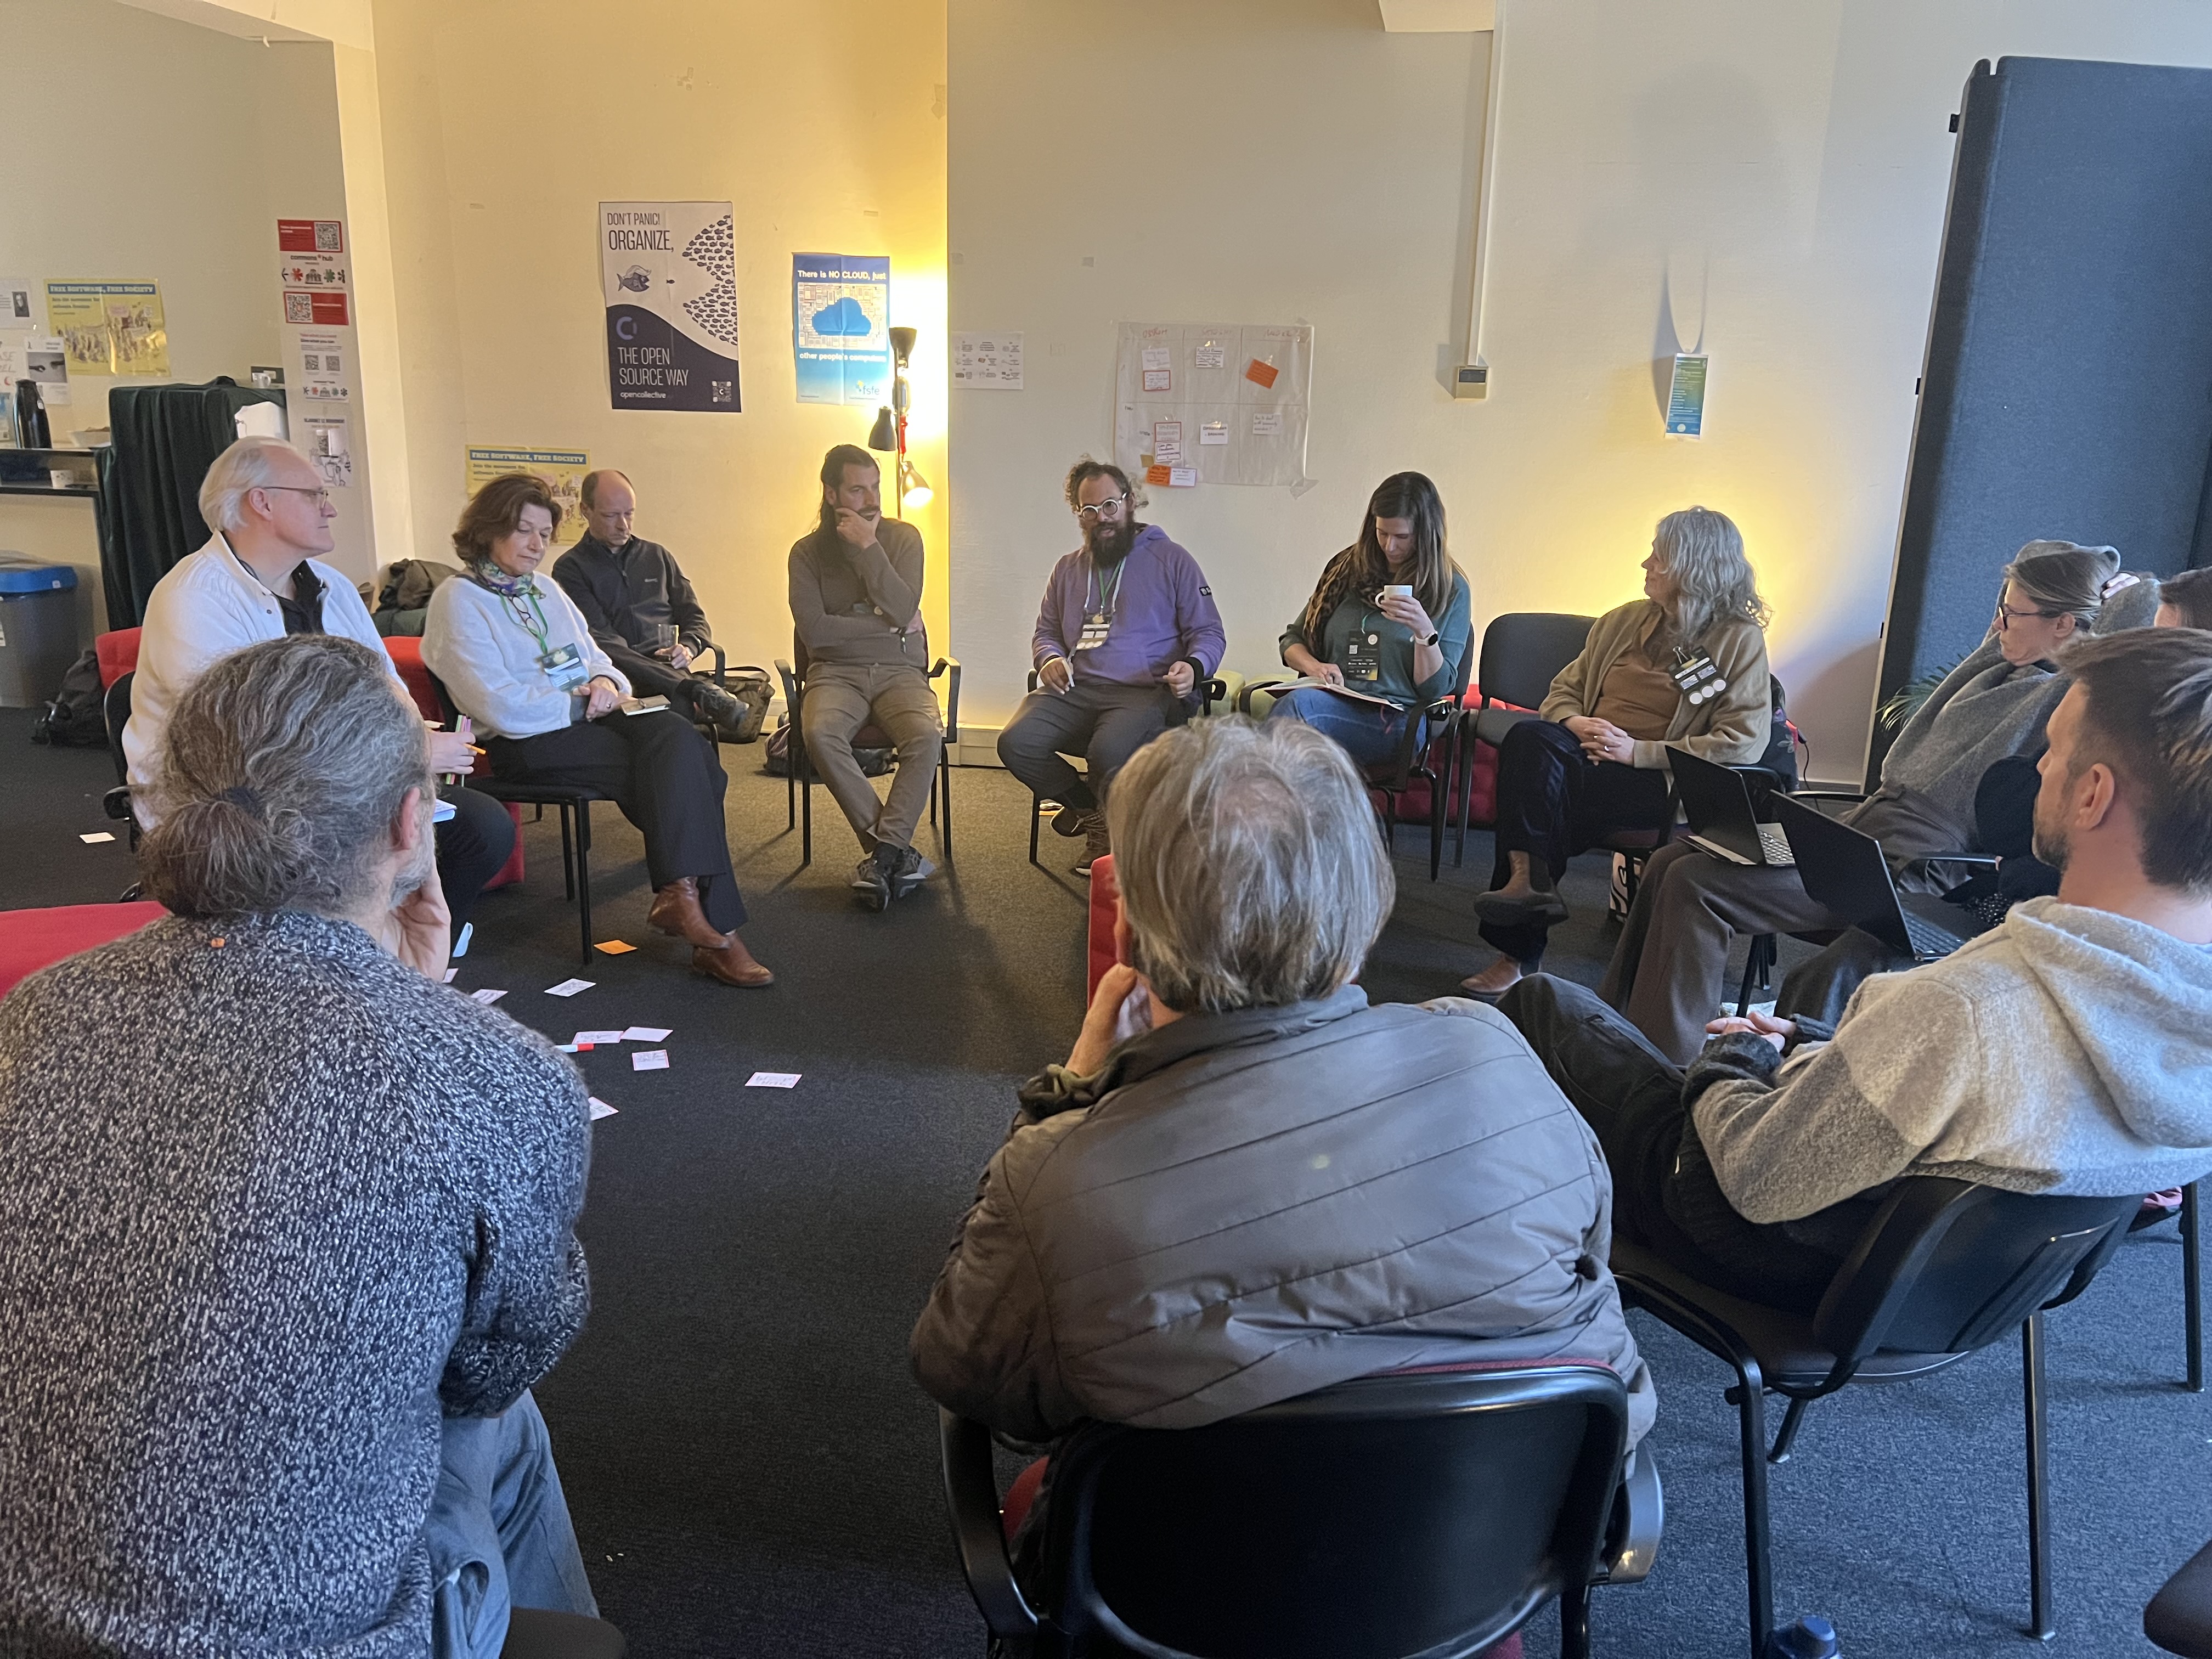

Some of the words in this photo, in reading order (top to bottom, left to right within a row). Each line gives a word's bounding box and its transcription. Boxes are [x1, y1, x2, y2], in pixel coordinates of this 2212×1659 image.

[607, 212, 632, 225] DON'T
[634, 212, 661, 225] PANIC!
[608, 230, 674, 252] ORGANIZE,
[797, 270, 818, 278] There
[842, 271, 870, 280] CLOUD,
[872, 272, 887, 281] just
[617, 347, 638, 364] THE
[641, 348, 670, 365] OPEN
[819, 353, 848, 361] people's
[619, 368, 663, 386] SOURCE
[665, 369, 689, 386] WAY
[862, 384, 880, 395] fsfe
